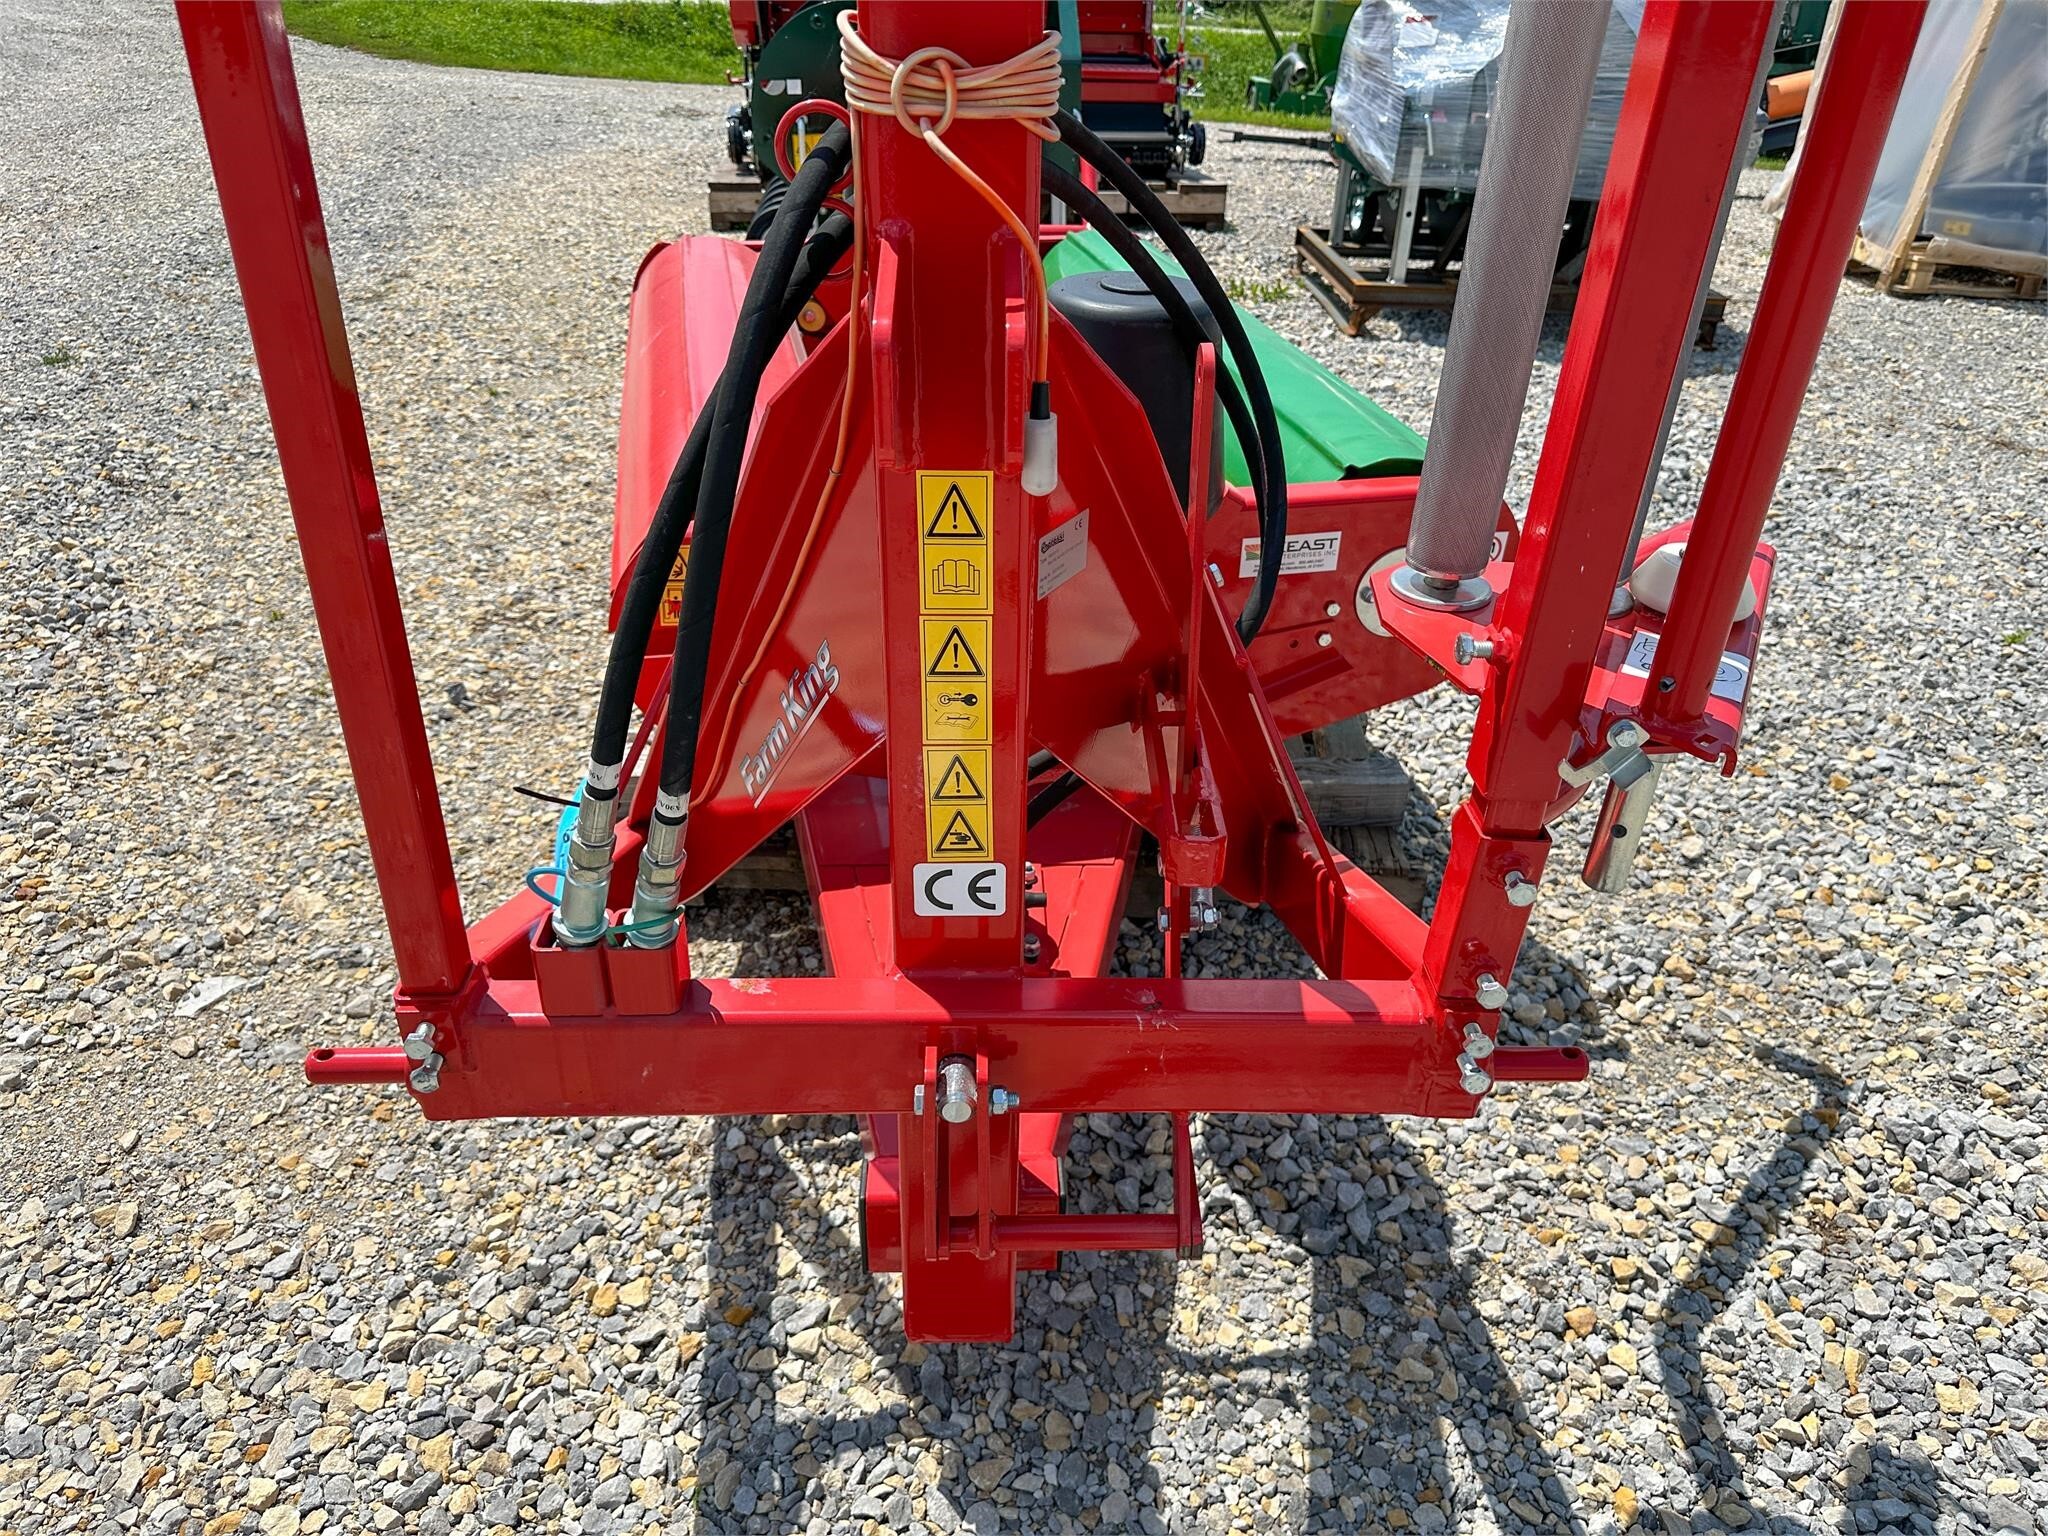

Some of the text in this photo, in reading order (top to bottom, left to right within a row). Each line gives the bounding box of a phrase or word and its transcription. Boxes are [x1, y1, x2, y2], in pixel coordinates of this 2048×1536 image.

[1283, 538, 1338, 552] EAST
[1283, 551, 1321, 560] TERPRISES
[738, 638, 840, 799] Farm King
[924, 869, 996, 910] CE
